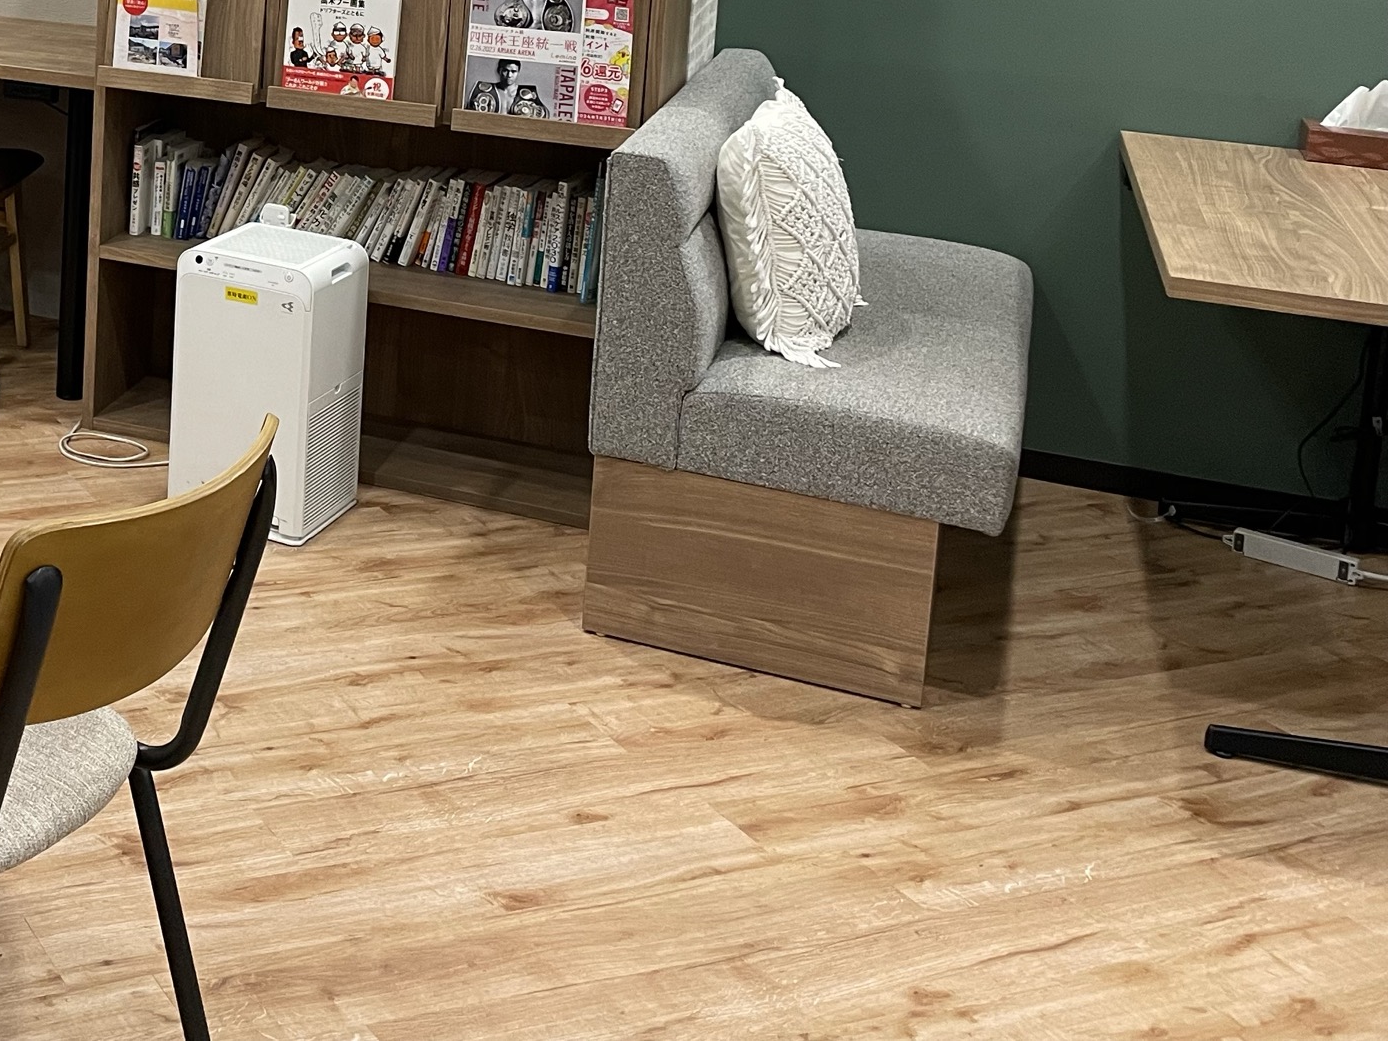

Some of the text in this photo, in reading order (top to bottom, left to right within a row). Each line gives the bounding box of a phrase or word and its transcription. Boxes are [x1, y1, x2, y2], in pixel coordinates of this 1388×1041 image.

[470, 31, 578, 53] 四団体王座統一戦
[517, 49, 536, 57] ARENA
[557, 67, 576, 122] TAPALE
